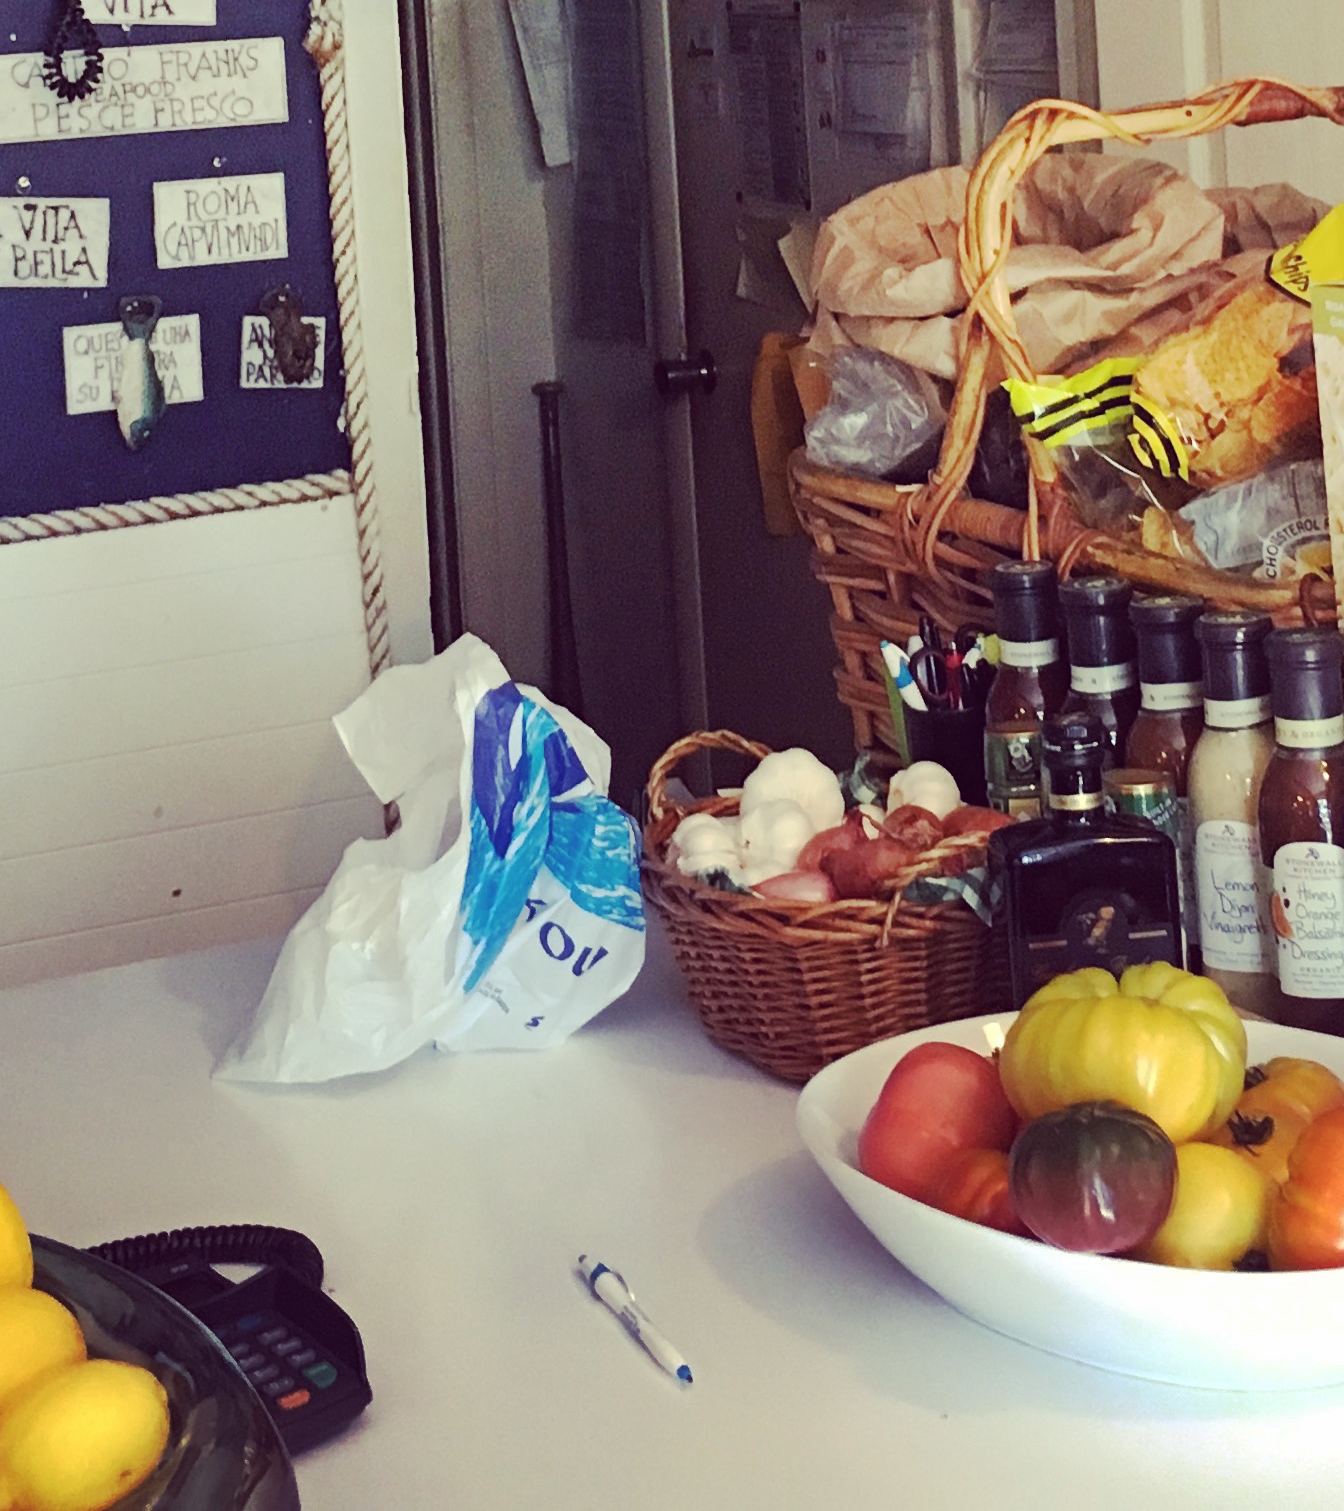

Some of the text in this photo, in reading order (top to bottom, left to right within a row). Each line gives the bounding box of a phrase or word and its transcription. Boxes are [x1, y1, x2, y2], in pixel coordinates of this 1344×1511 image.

[158, 45, 260, 83] FRANKS
[31, 91, 254, 137] PESCE FRESCO
[184, 184, 260, 222] ROMA
[13, 202, 87, 245] VITA
[10, 244, 99, 282] BELLA
